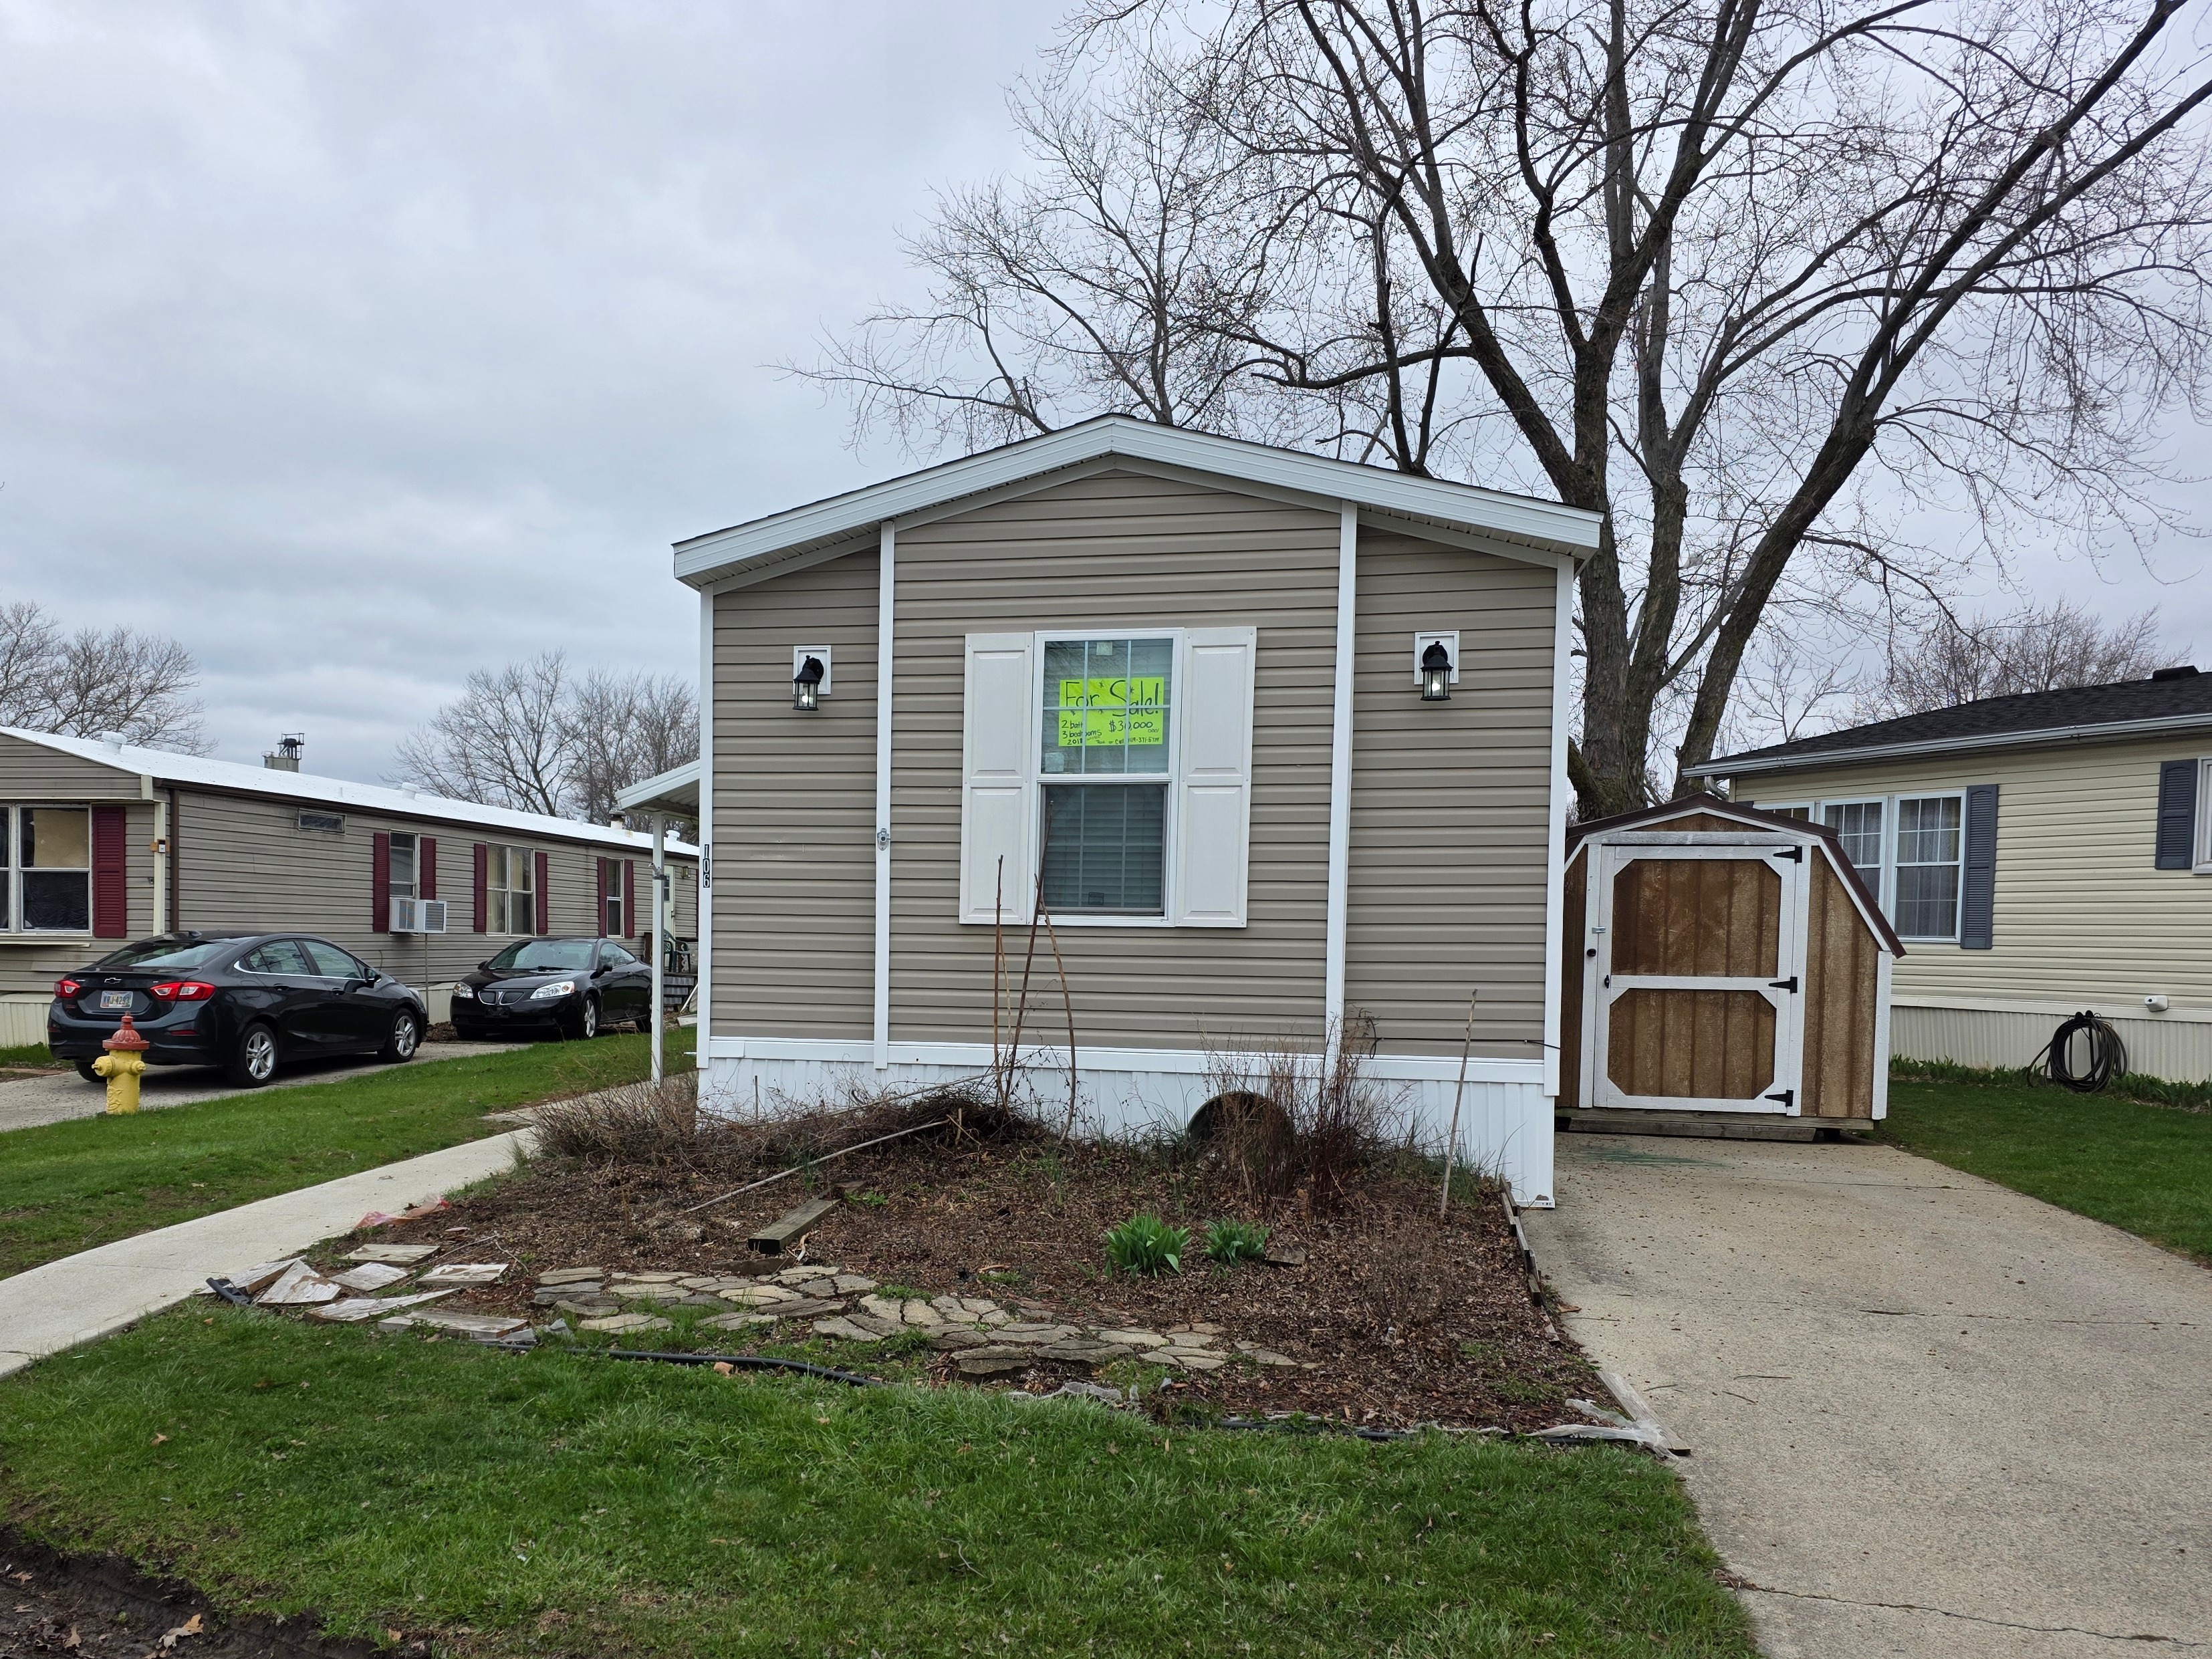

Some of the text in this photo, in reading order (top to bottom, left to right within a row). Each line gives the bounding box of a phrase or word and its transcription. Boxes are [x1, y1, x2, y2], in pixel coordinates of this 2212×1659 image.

[1066, 679, 1159, 717] For Sale!
[1061, 720, 1070, 729] 2
[1062, 730, 1068, 739] 3
